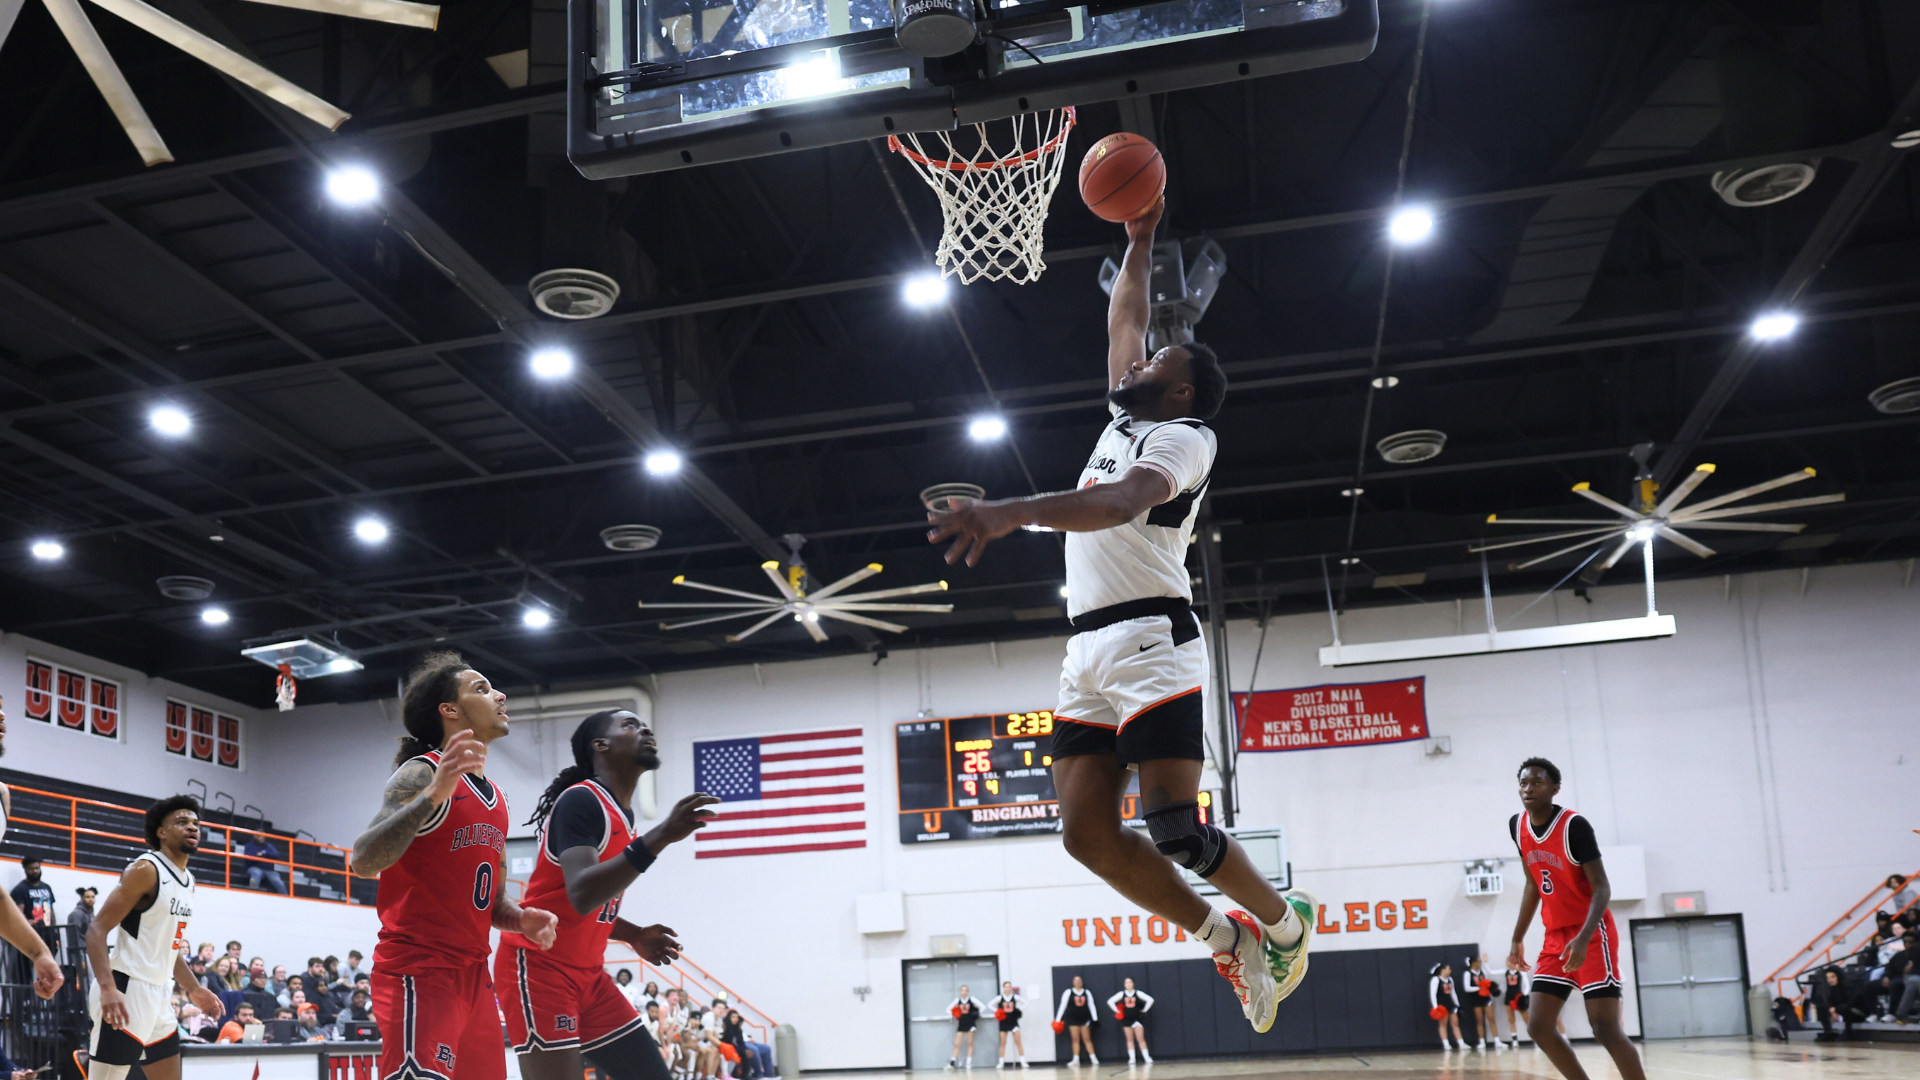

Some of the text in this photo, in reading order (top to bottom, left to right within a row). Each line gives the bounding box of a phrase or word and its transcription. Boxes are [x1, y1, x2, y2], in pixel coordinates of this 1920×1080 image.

[902, 0, 954, 19] SPALDING
[58, 672, 85, 727] U
[92, 682, 117, 736] U
[1293, 689, 1362, 706] 2017 NAIA
[1290, 702, 1365, 719] DIVISION II
[1007, 711, 1053, 736] 2:33
[1263, 712, 1399, 733] MEN'S BASKETBALL
[1262, 725, 1402, 747] NATIONAL CHAMPION
[963, 750, 991, 774] 26
[1024, 750, 1032, 766] 1
[963, 779, 1000, 797] 9 4
[923, 812, 942, 833] U
[971, 804, 1047, 823] BINGHAM
[472, 861, 493, 911] 0
[1540, 869, 1554, 896] 5
[1316, 898, 1429, 935] LEGE
[556, 1014, 578, 1033] BU
[435, 1043, 457, 1072] BU
